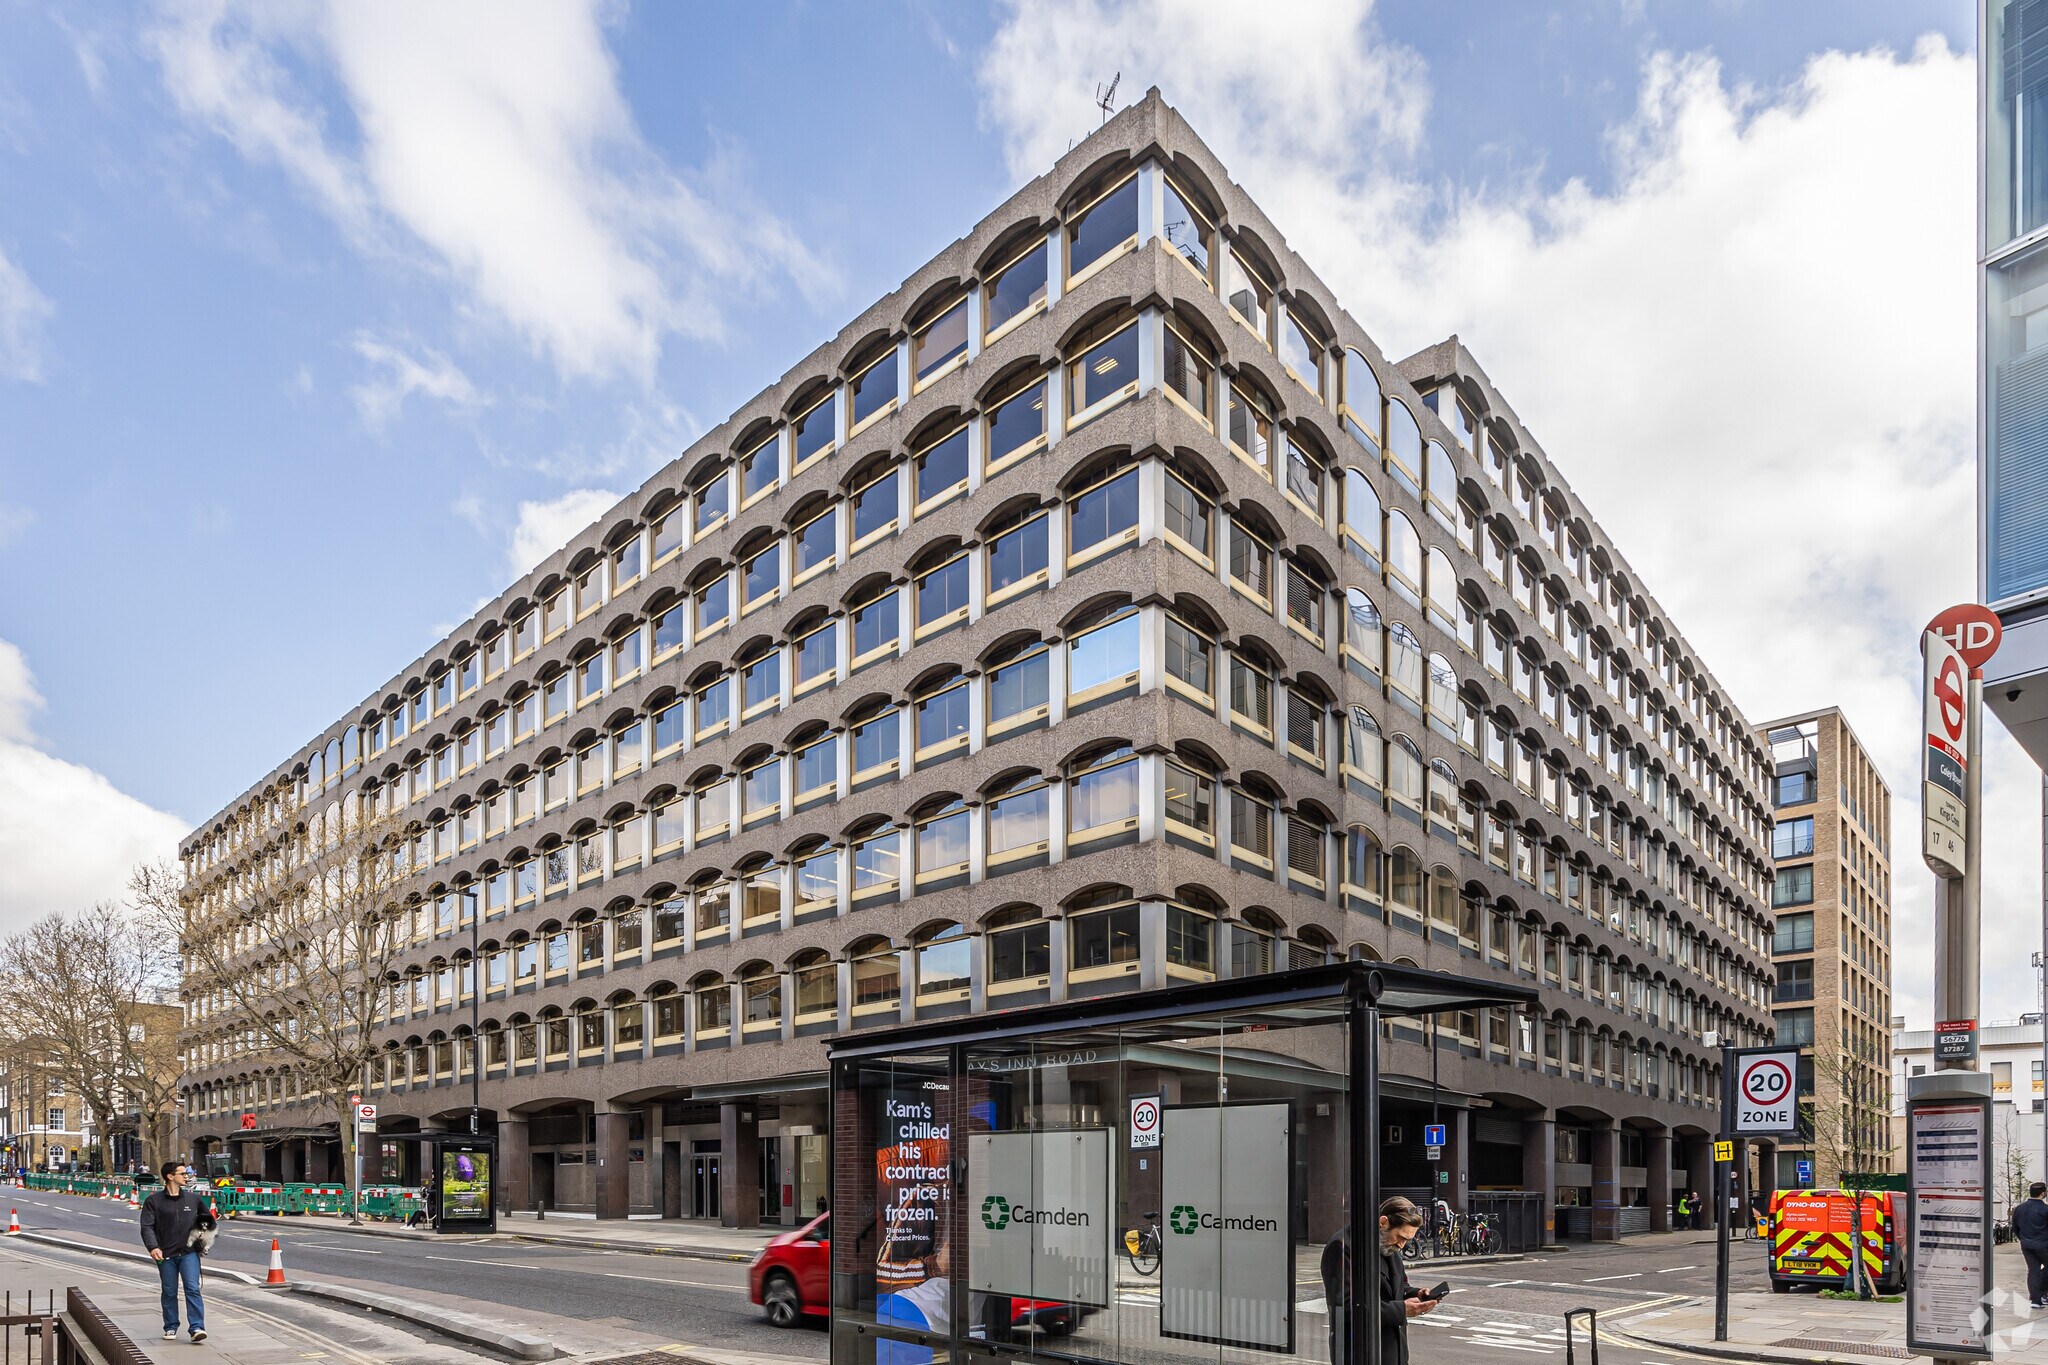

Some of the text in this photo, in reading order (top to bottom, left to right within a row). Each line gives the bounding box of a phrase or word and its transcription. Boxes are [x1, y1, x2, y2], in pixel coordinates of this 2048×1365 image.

[1936, 622, 1995, 651] HD
[1940, 764, 1952, 781] Coley
[1932, 831, 1954, 853] 17 46
[1943, 1045, 1965, 1053] 87287
[968, 1050, 1097, 1073] AY'S INN ROAD
[922, 1082, 949, 1090] JCDecau
[1750, 1073, 1784, 1092] 20
[886, 1099, 931, 1119] Kam's
[1137, 1110, 1154, 1123] 20
[1743, 1111, 1788, 1123] ZONE
[899, 1122, 949, 1140] chilled
[1134, 1133, 1156, 1143] ZONE
[899, 1142, 921, 1159] his
[885, 1164, 950, 1180] contract
[899, 1183, 939, 1205] price
[885, 1204, 938, 1221] frozen.
[1012, 1205, 1089, 1227] Camden
[1200, 1213, 1278, 1232] Camden
[885, 1234, 911, 1242] Cubcard
